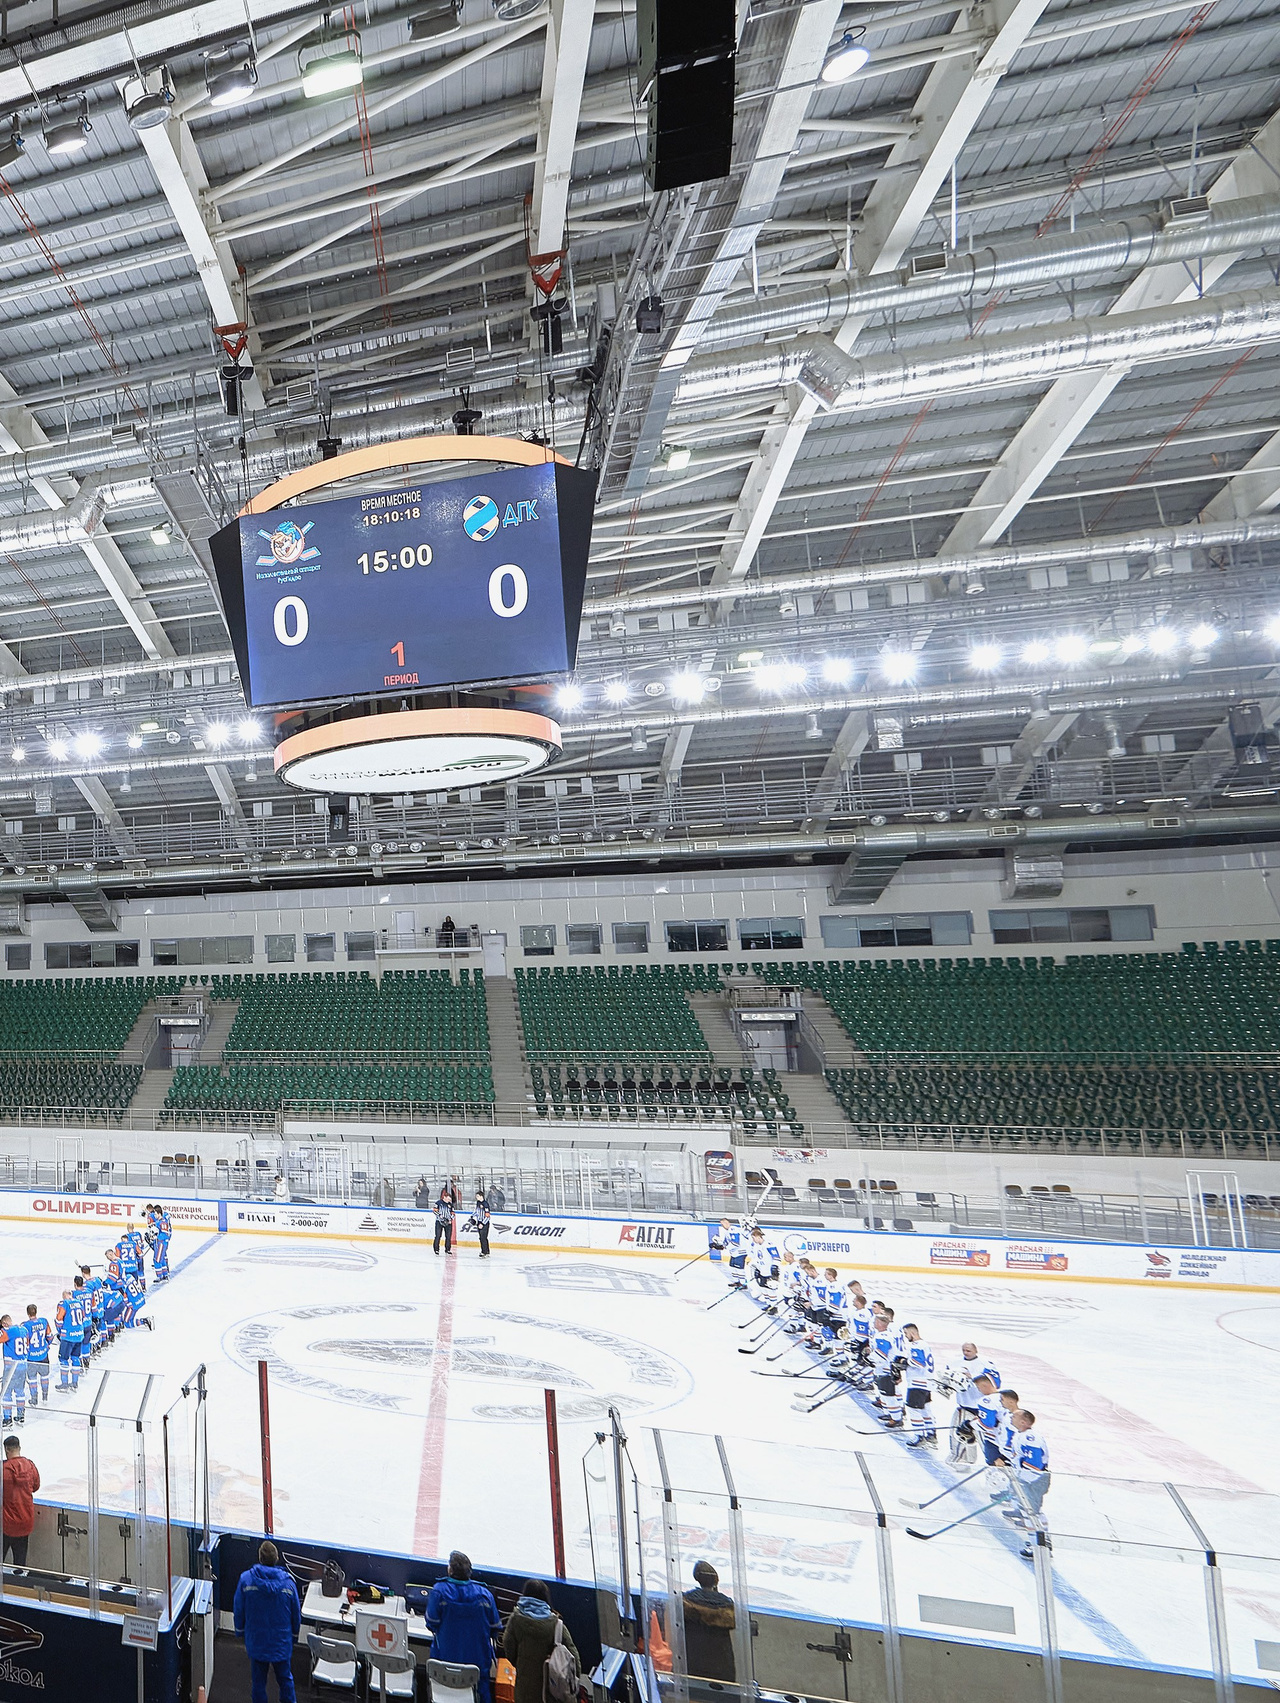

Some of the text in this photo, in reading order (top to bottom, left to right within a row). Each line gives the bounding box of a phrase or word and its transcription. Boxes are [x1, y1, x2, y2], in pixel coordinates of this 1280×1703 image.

[361, 490, 422, 511] ВРЕМЯ МЕСТНОЕ
[362, 507, 421, 527] 18:10:18
[502, 499, 540, 529] ДГК
[356, 543, 433, 576] 15:00
[487, 563, 529, 618] 0
[273, 595, 309, 647] 0
[389, 641, 405, 667] 1
[383, 672, 419, 687] ПЕРИОД
[32, 1199, 135, 1217] OLIMPBET
[162, 1205, 202, 1213] ФЕДЕРАЦИЯ
[190, 1213, 218, 1221] РОССИИ
[290, 1219, 328, 1227] 2-000-007
[513, 1225, 567, 1238] СОКОЛ!
[635, 1242, 676, 1250] АВТОХОЛДИНГ
[807, 1241, 850, 1253] БУРЭНЕРГО
[933, 1241, 967, 1249] КРАСНАЯ
[1008, 1245, 1044, 1253] КРАСНАЯ
[121, 1248, 136, 1261] 24
[931, 1248, 968, 1258] МАШИНА
[1007, 1252, 1045, 1262] МАШИНА
[70, 1308, 83, 1327] 10
[30, 1329, 46, 1348] 47
